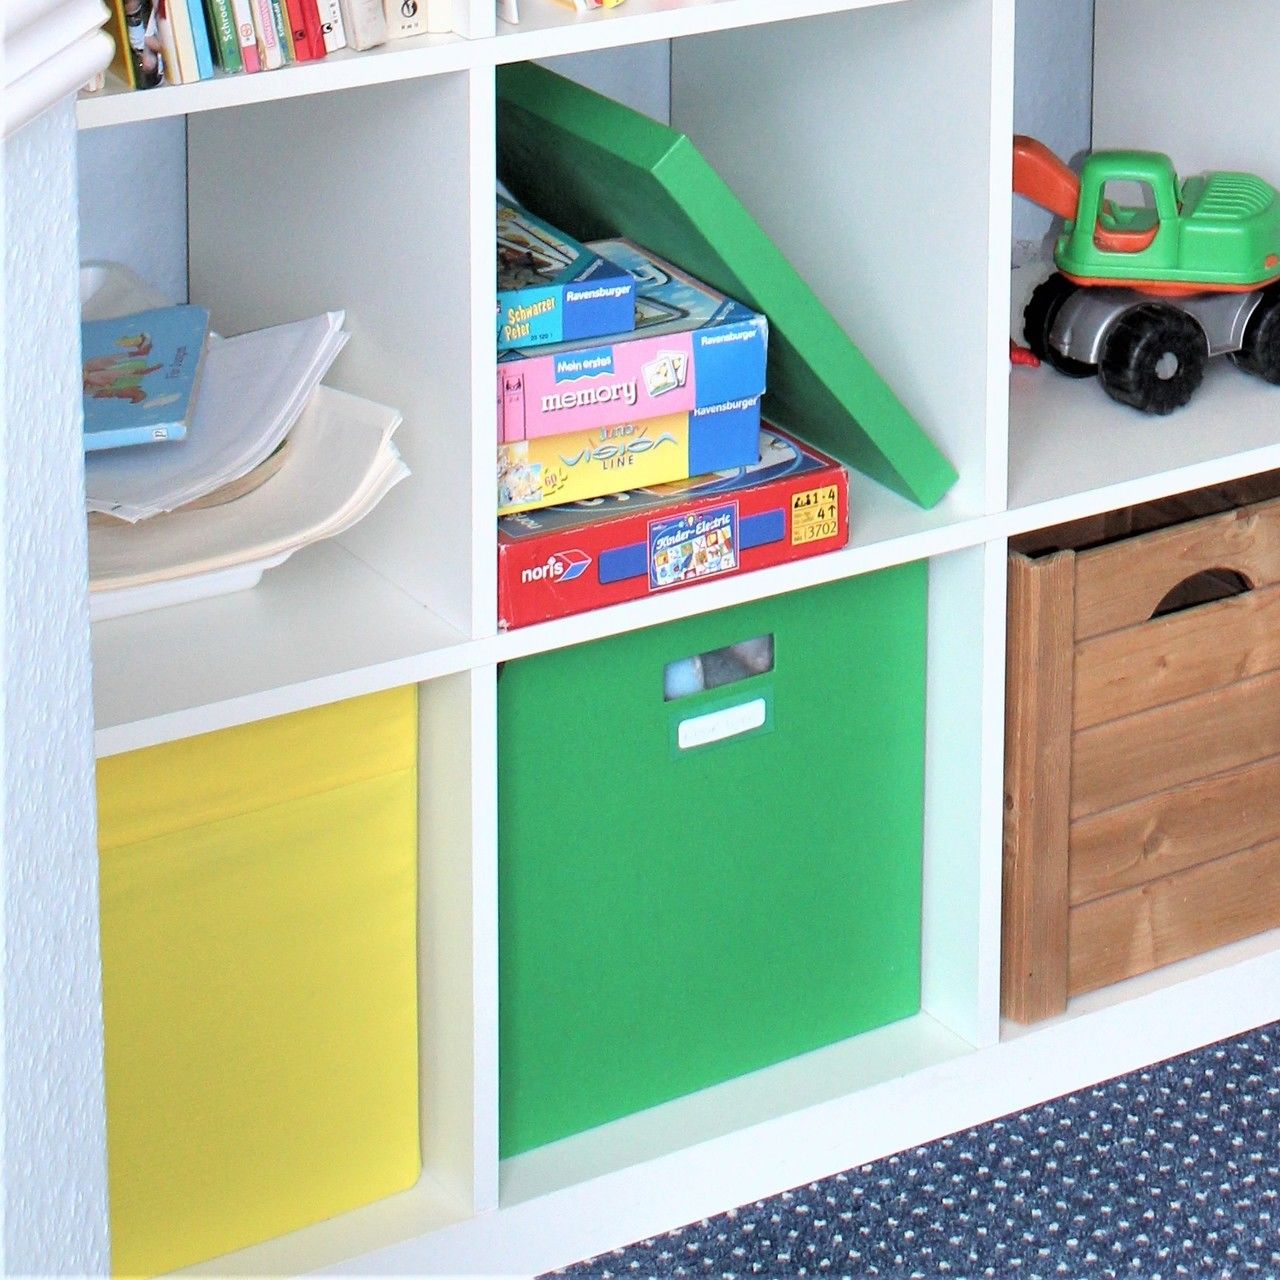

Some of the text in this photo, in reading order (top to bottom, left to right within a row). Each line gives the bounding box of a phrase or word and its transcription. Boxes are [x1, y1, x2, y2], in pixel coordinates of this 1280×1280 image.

[566, 285, 631, 302] Ravensburger
[508, 296, 556, 325] Schwarzer
[504, 322, 531, 341] Peter
[701, 328, 758, 346] Ravensburger
[540, 377, 637, 413] memory
[602, 456, 635, 470] LINE
[817, 507, 825, 519] 4
[808, 521, 837, 539] 3702
[522, 557, 565, 584] noris
